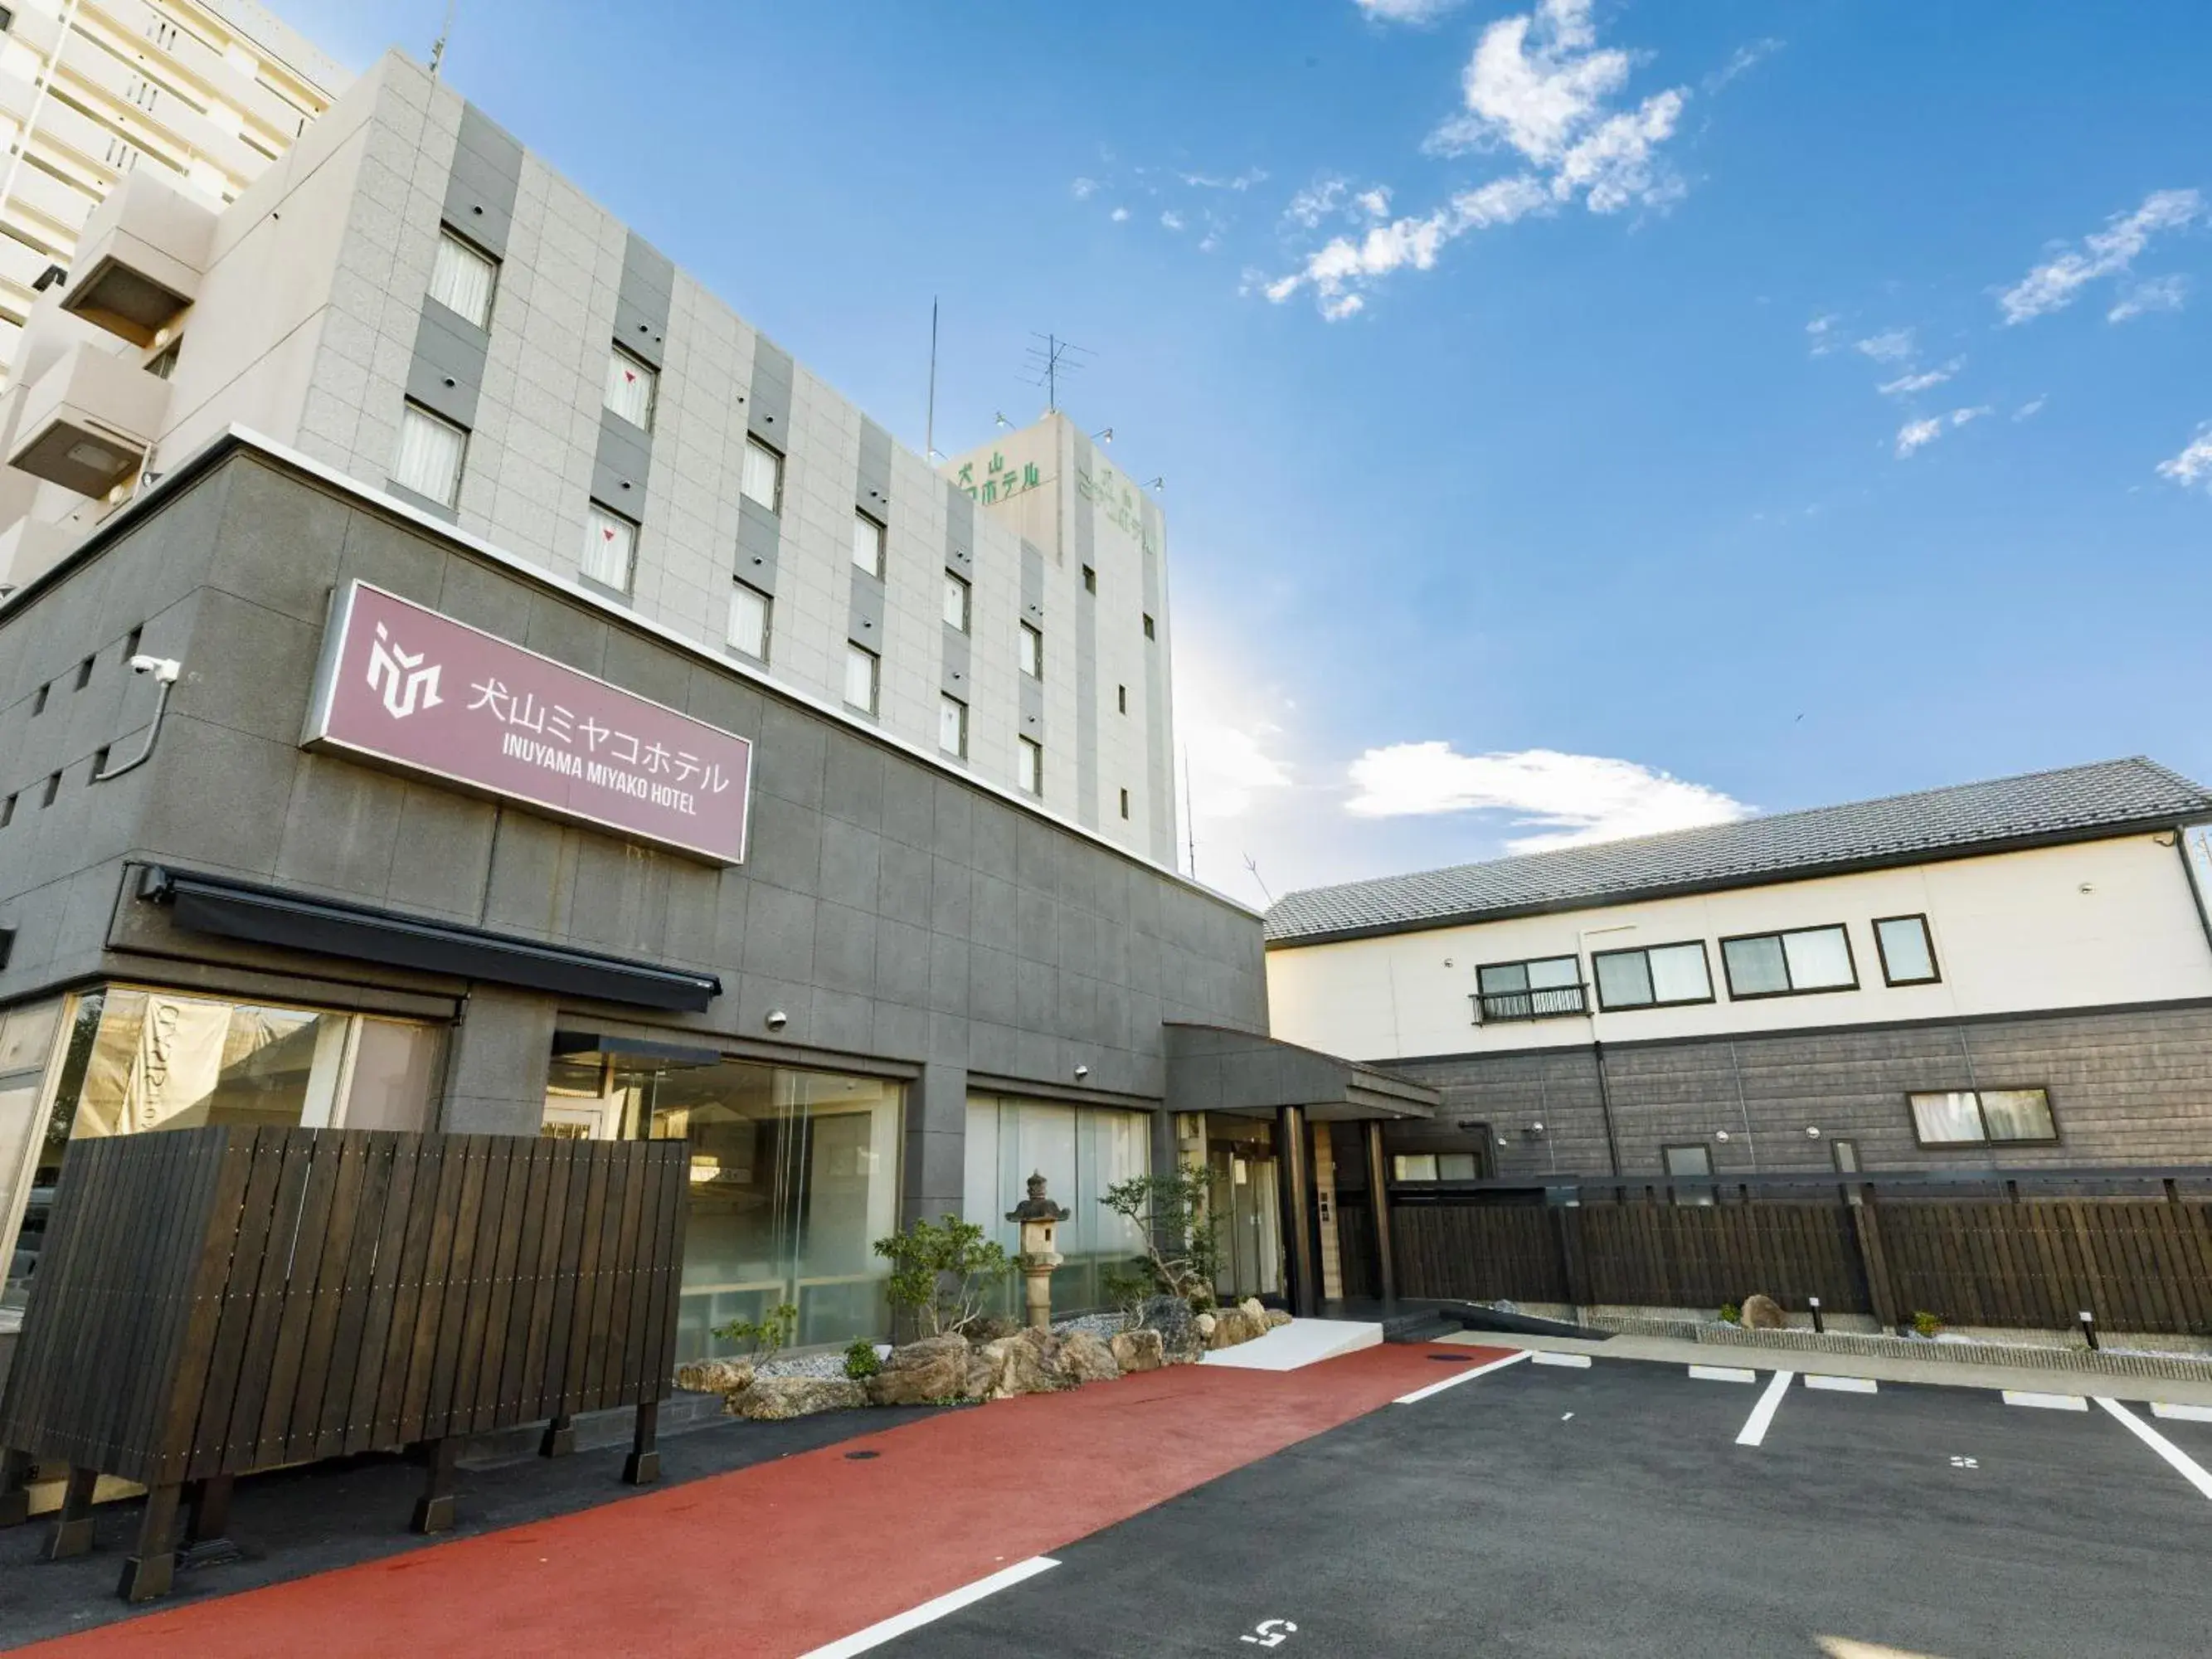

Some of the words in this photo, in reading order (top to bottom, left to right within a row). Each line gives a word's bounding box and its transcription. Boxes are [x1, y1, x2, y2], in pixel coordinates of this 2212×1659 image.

[467, 678, 730, 793] 犬山ミヤコホテル
[503, 732, 582, 779] INUYAMA
[586, 761, 648, 799] MIYAKO
[651, 782, 697, 815] HOTEL
[1240, 1619, 1298, 1647] 5
